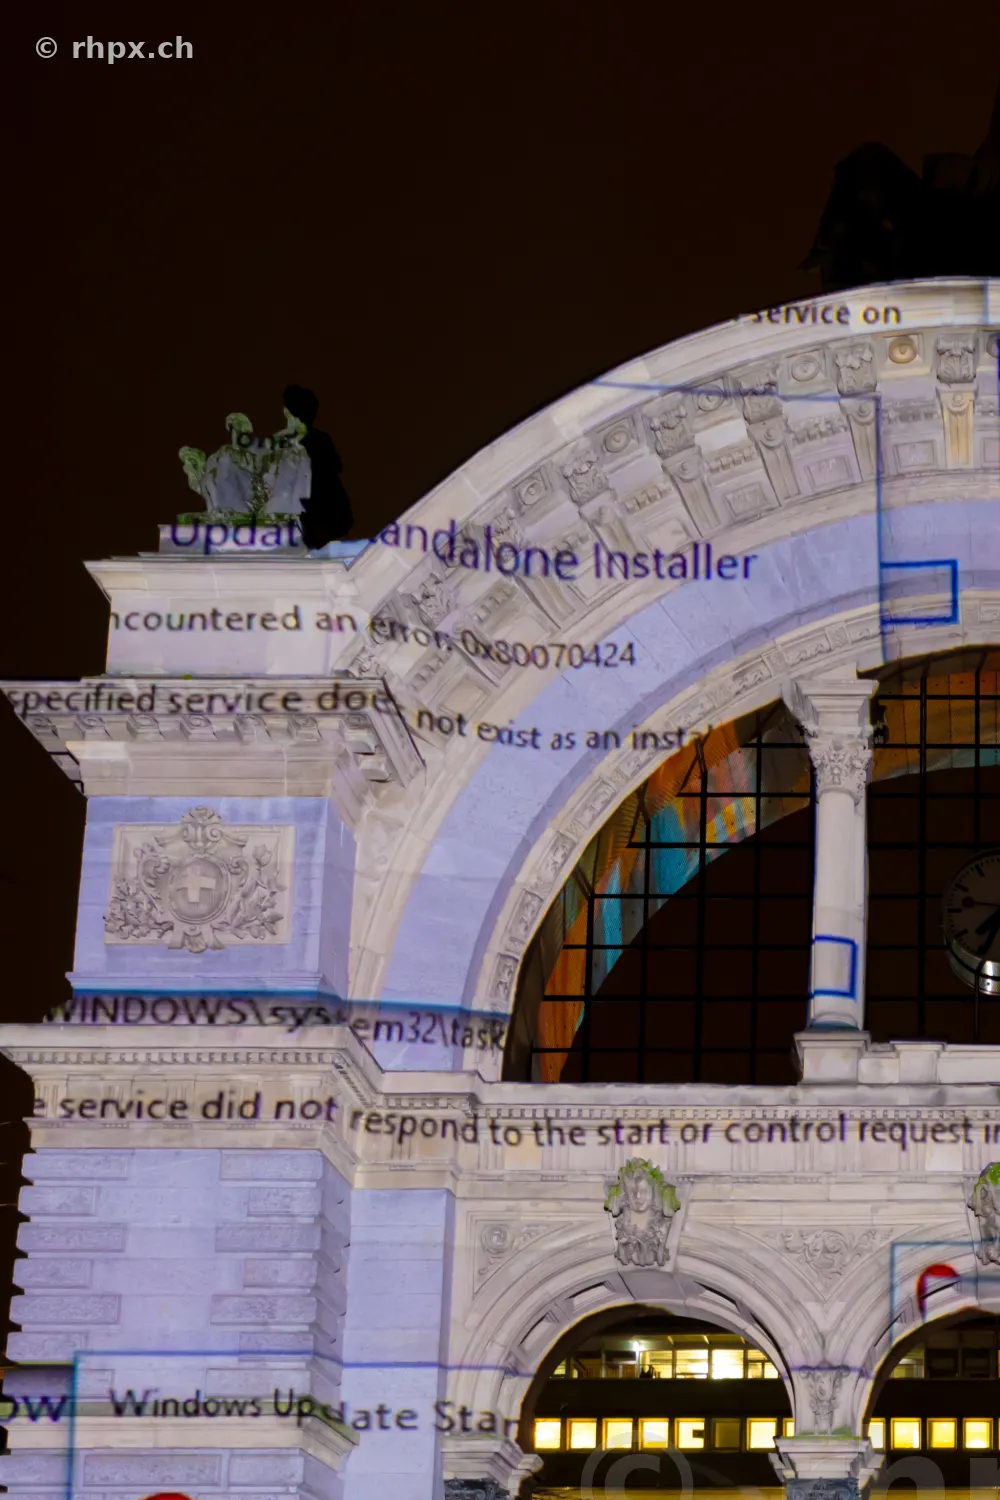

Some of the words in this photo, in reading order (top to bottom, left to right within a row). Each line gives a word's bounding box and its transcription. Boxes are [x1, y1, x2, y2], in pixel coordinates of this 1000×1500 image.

[861, 303, 902, 324] on
[593, 541, 759, 581] Installer
[315, 610, 358, 635] an
[460, 628, 638, 670] 0x80070424
[167, 687, 303, 715] service
[416, 708, 467, 738] not
[476, 718, 542, 750] exist
[550, 730, 576, 751] as
[586, 727, 621, 751] an
[58, 1088, 189, 1120] service
[201, 1090, 262, 1121] did
[273, 1094, 339, 1122] not
[349, 1108, 479, 1144] respond
[489, 1117, 523, 1147] to
[532, 1116, 587, 1147] the
[595, 1117, 671, 1147] start
[680, 1121, 715, 1144] or
[723, 1111, 848, 1144] control
[857, 1115, 973, 1152] request
[109, 1388, 264, 1421] Windows
[272, 1388, 419, 1432] Update
